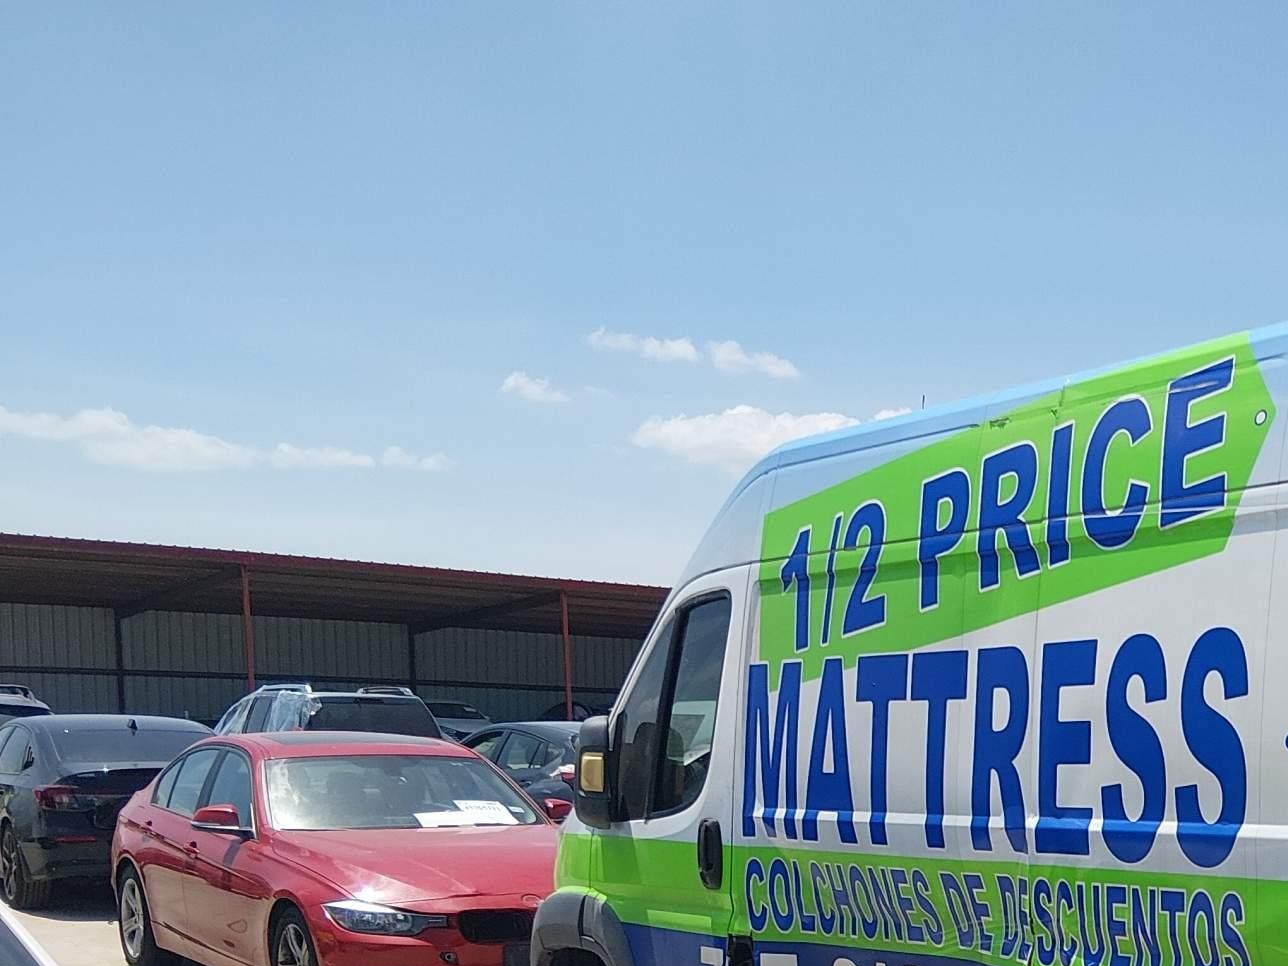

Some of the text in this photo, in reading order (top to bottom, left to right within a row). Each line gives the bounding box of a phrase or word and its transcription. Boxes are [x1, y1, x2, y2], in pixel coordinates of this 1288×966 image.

[780, 356, 1236, 653] 1/2 PRICE
[742, 627, 1248, 869] MATTRESS
[745, 858, 945, 948] COLCHONES
[939, 870, 995, 956] DE
